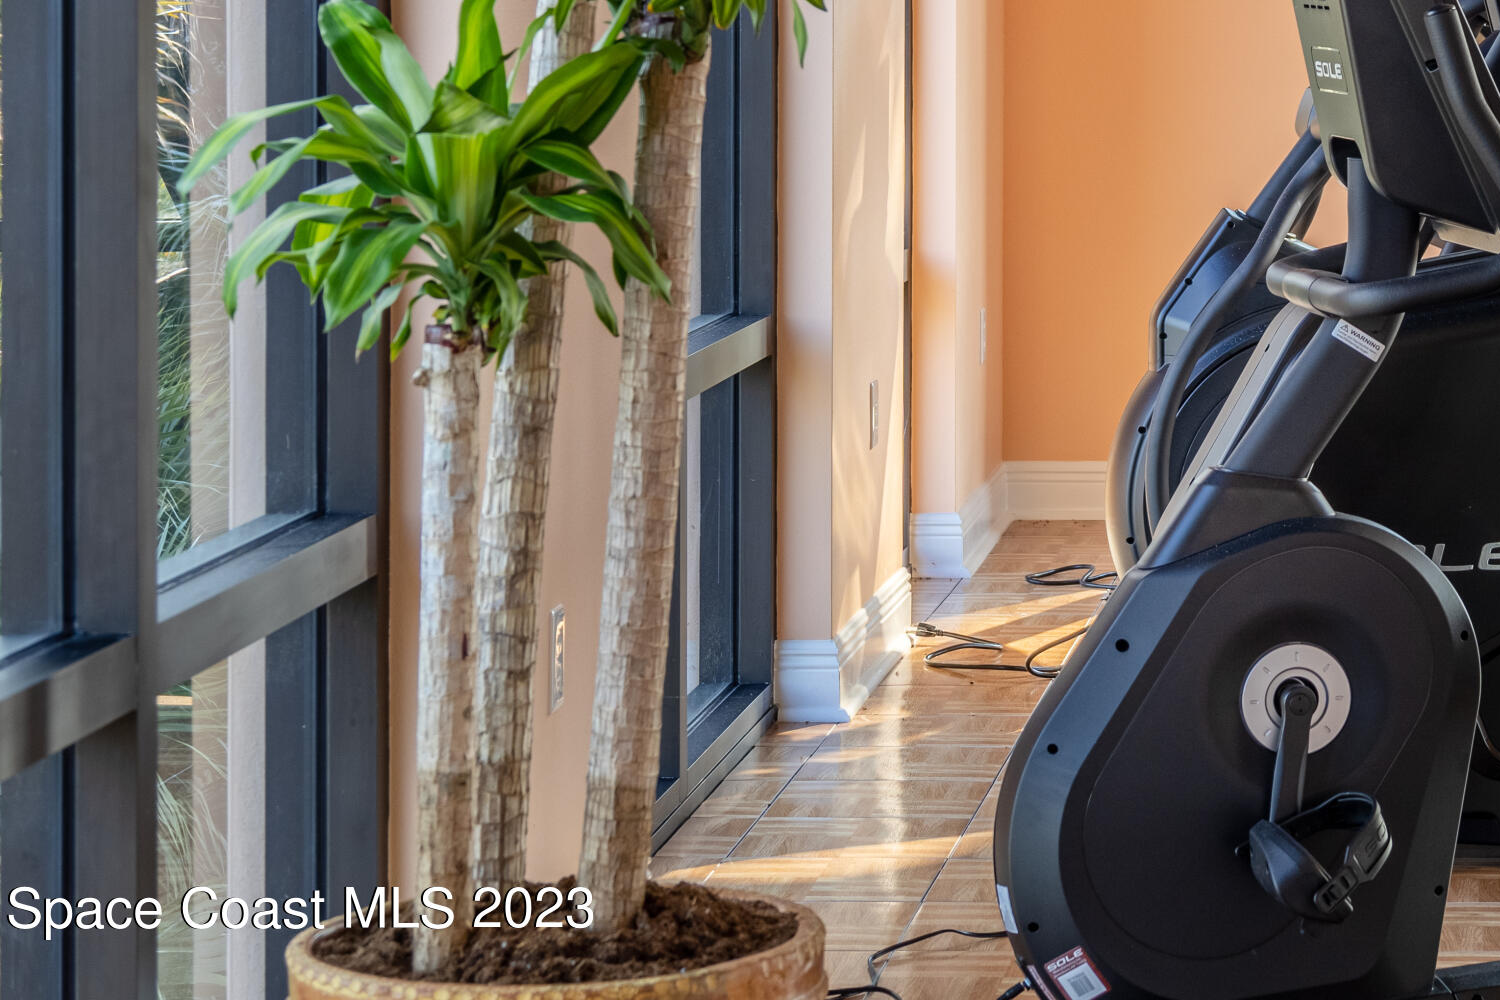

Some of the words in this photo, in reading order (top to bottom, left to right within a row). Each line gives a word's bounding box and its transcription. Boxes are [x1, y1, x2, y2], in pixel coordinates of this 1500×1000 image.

[1315, 61, 1343, 79] SOLE
[1350, 328, 1381, 351] WARNING
[1047, 948, 1084, 971] SOLE
